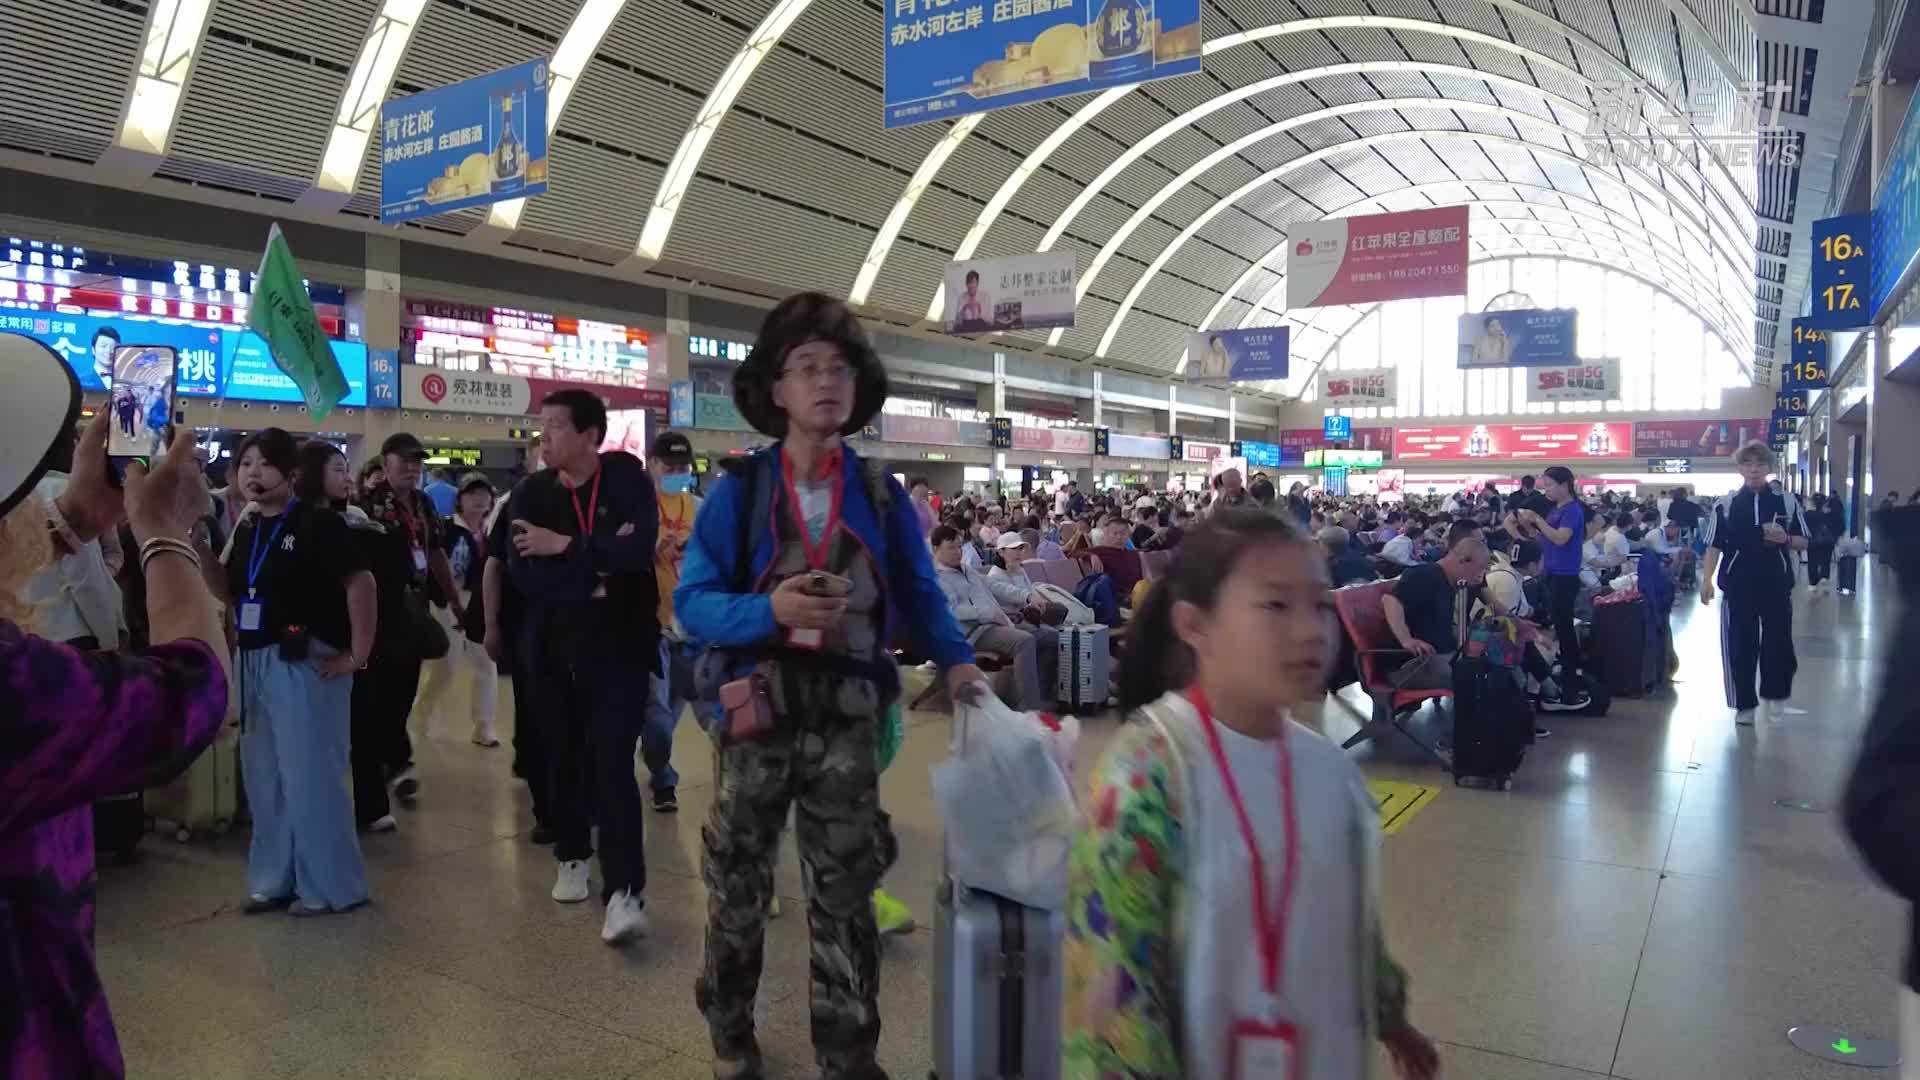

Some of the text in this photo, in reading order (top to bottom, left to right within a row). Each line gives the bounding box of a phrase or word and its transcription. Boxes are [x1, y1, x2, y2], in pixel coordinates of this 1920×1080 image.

[891, 5, 984, 46] 赤水河左岸
[383, 109, 434, 143] 青花郎
[383, 136, 434, 163] 赤水河左岸
[1351, 226, 1461, 252] 红苹果全屋整配
[1819, 235, 1864, 262] 16A
[1822, 284, 1860, 311] 17A
[1793, 326, 1826, 345] 14A
[177, 348, 217, 383] 桃
[1793, 362, 1826, 380] 15A
